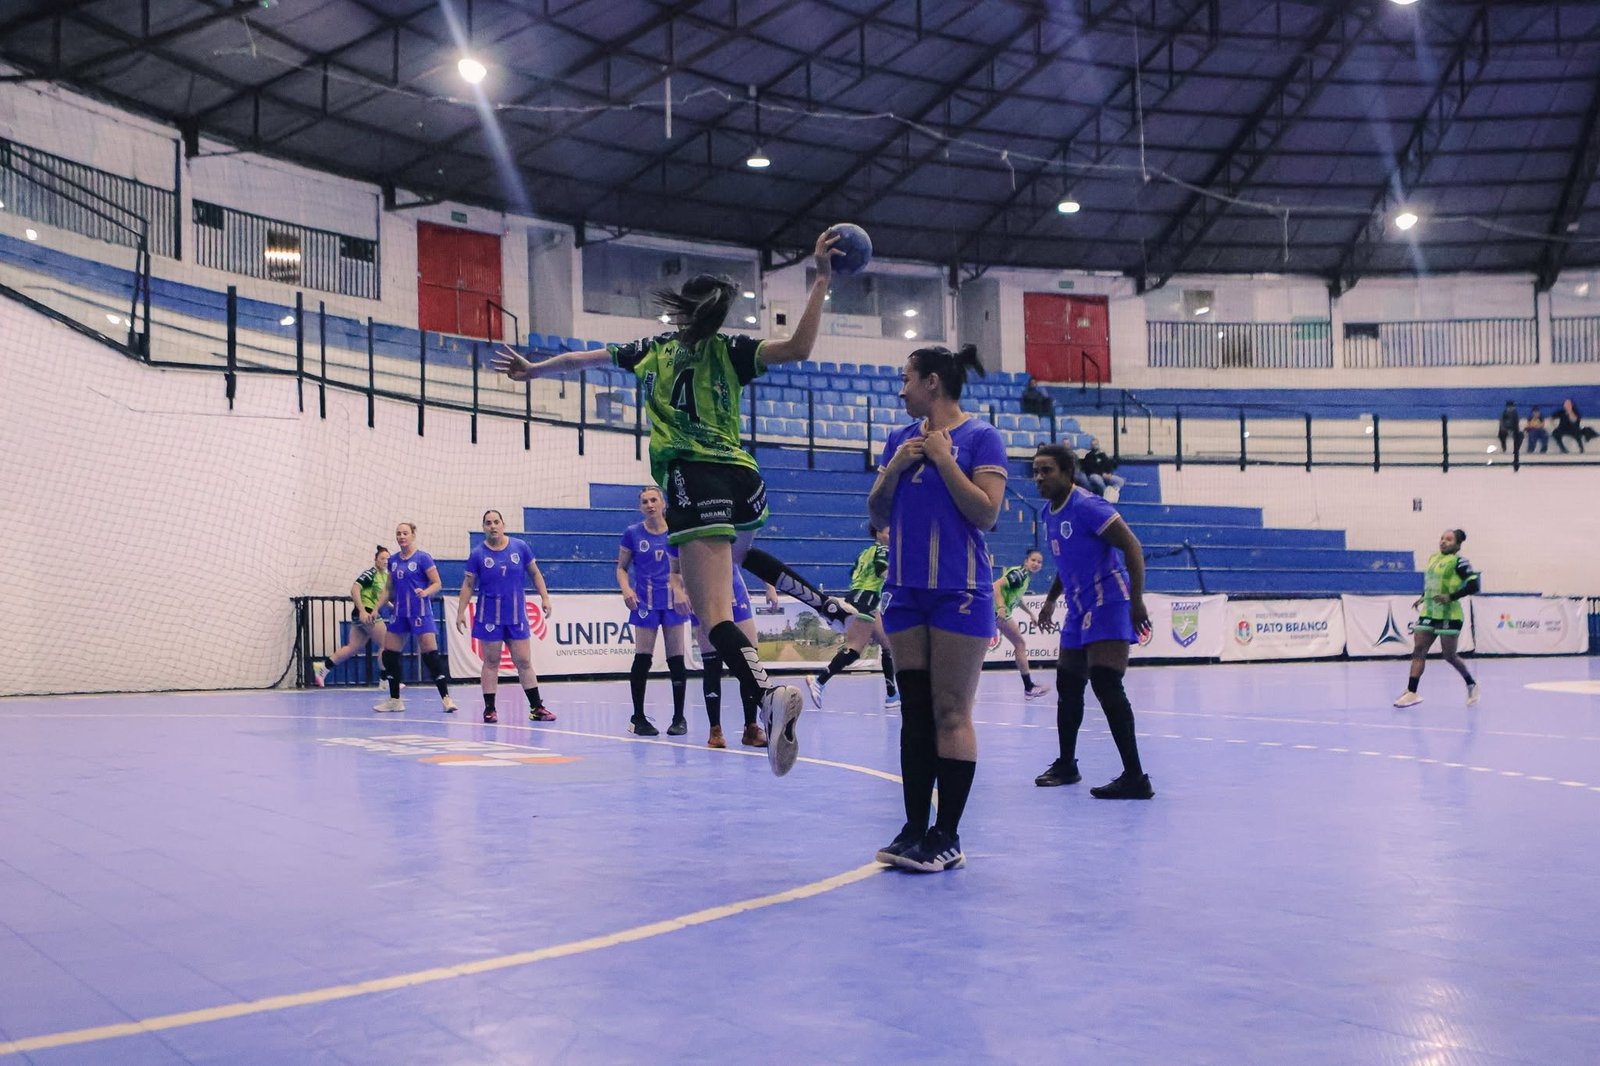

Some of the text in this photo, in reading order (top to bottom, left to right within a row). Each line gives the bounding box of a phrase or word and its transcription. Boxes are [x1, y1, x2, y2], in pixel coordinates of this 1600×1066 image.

[669, 367, 701, 424] 4
[911, 464, 925, 484] 2
[500, 566, 507, 577] 7
[959, 590, 974, 615] 2
[1256, 621, 1328, 633] PATO BRANCO
[1005, 649, 1051, 657] HADEBOL
